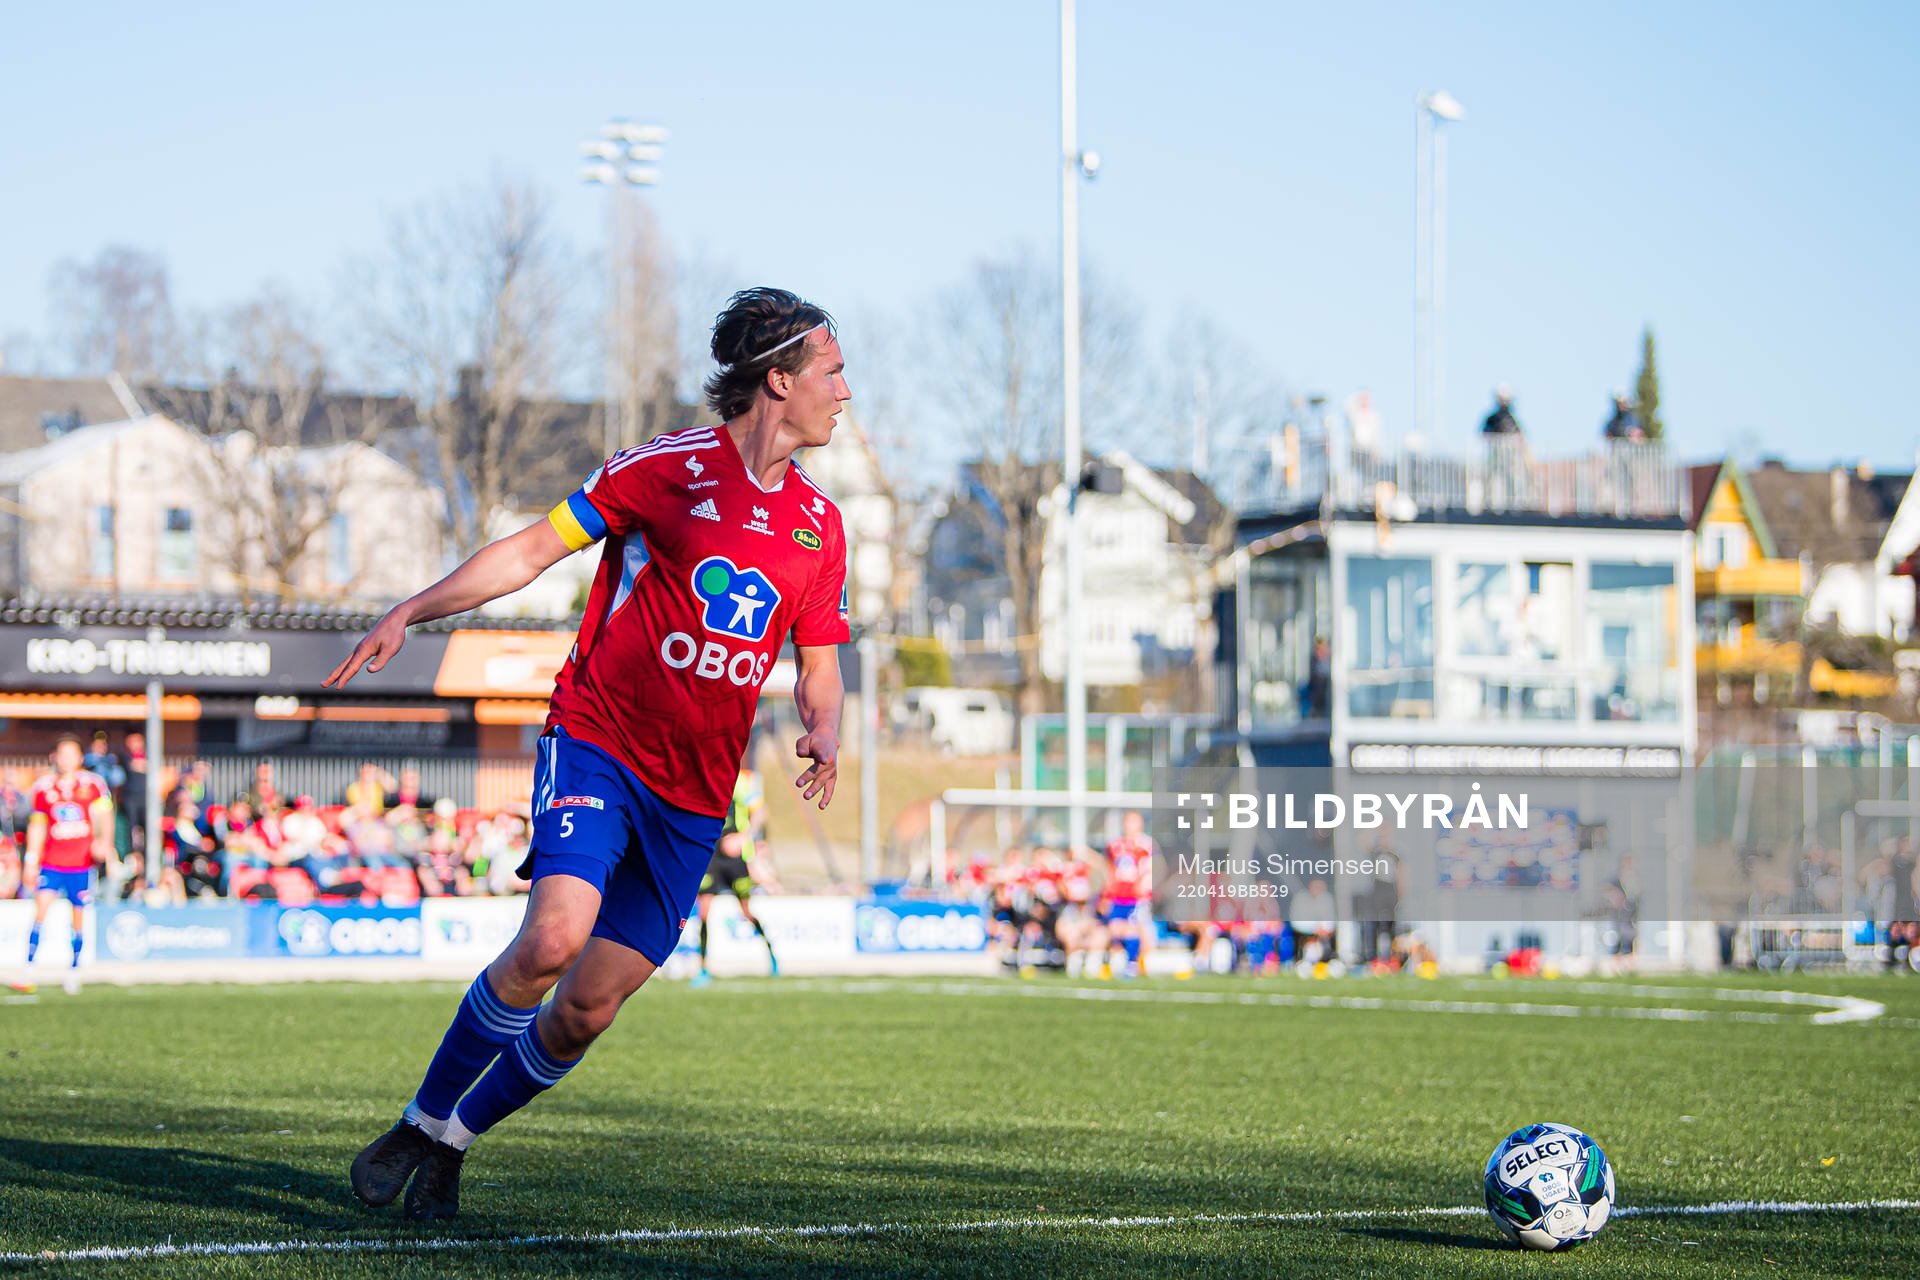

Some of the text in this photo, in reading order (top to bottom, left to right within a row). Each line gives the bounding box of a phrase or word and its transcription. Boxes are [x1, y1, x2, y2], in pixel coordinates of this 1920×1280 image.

[690, 508, 721, 522] adidas
[661, 631, 769, 687] OBOS
[559, 797, 591, 806] SPAR
[559, 812, 574, 838] 5
[1505, 1139, 1569, 1178] SELECT
[1542, 1187, 1567, 1200] LIGAEN
